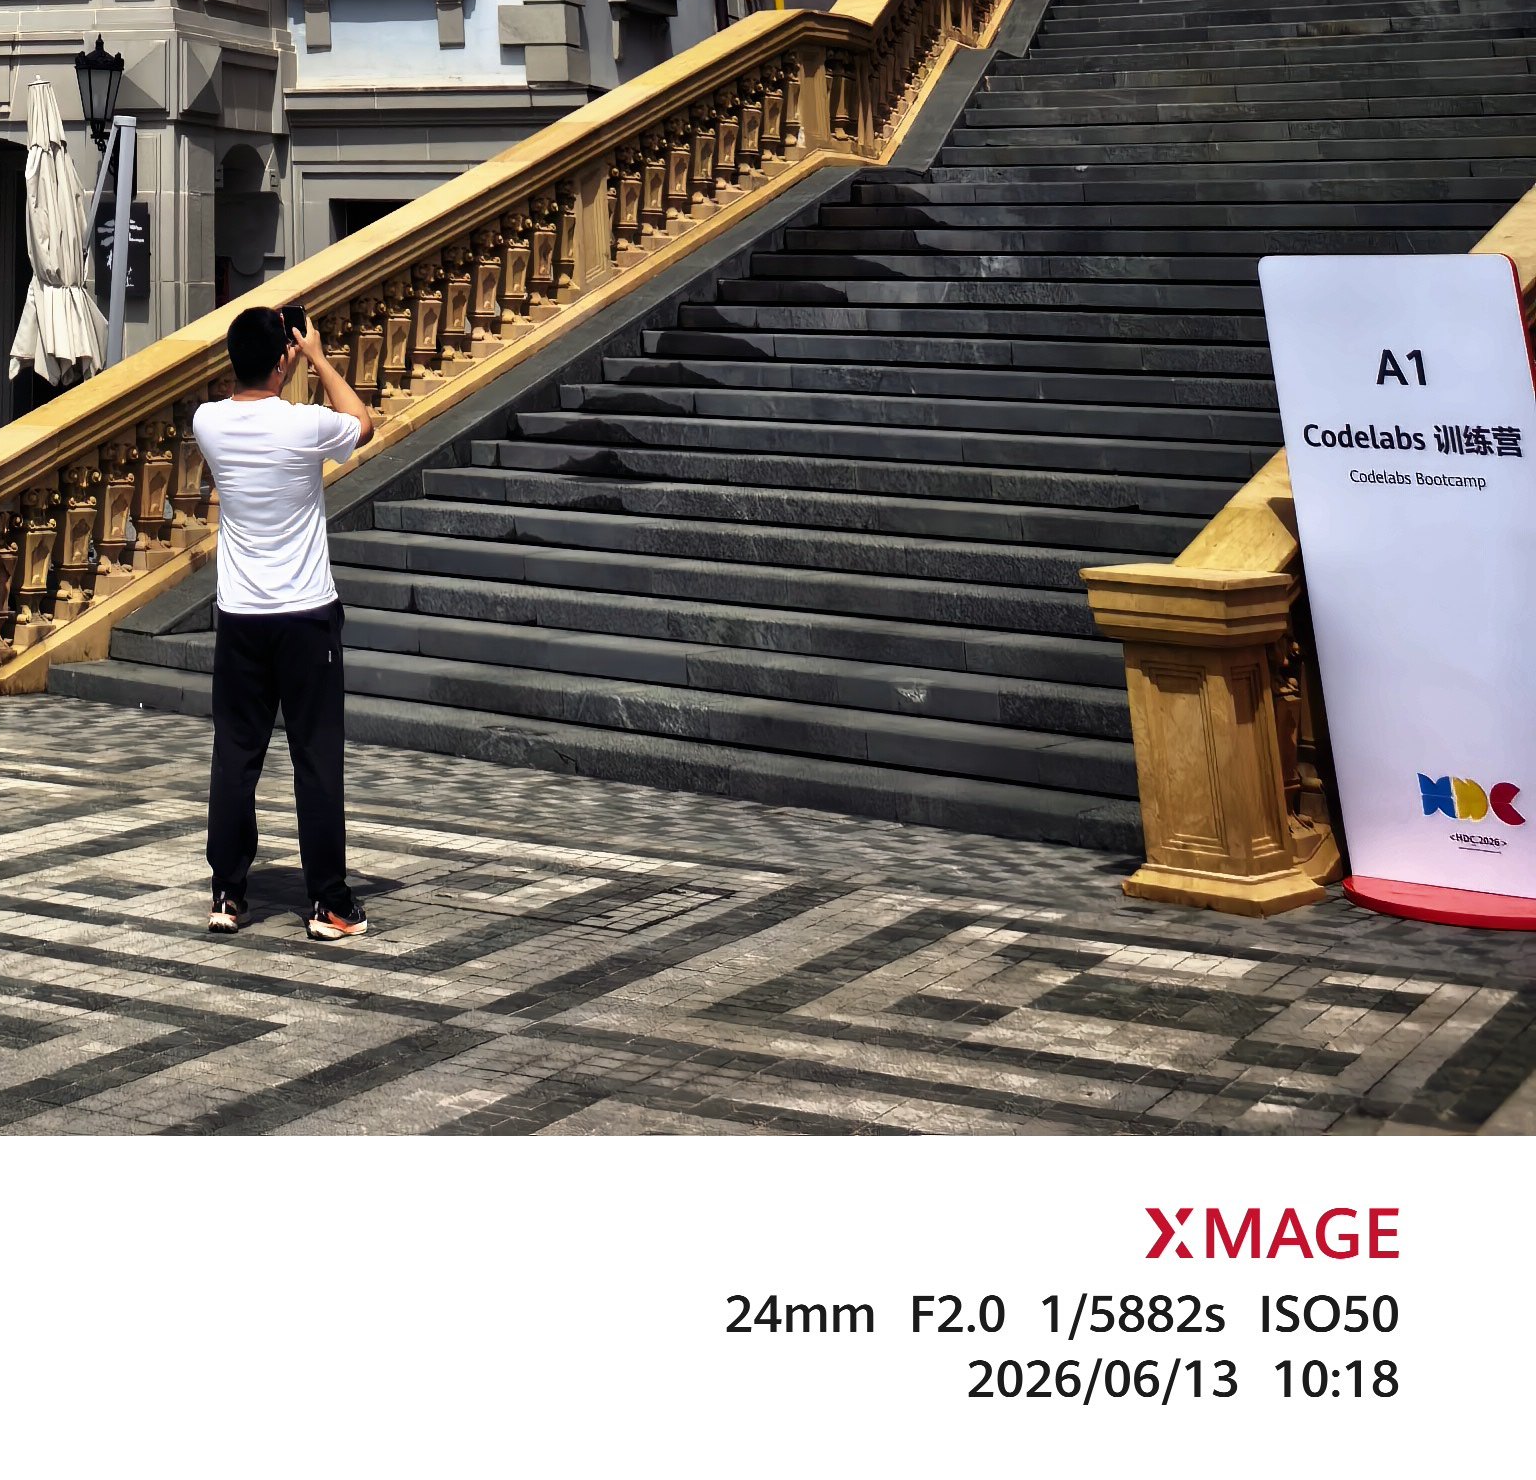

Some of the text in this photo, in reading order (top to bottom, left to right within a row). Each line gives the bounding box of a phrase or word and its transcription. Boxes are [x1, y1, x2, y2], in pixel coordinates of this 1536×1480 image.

[1376, 349, 1427, 386] A1
[1303, 423, 1523, 458] Codelabs 训练营
[1349, 469, 1487, 491] Codelabs Bootcamp
[1417, 773, 1526, 826] HDC
